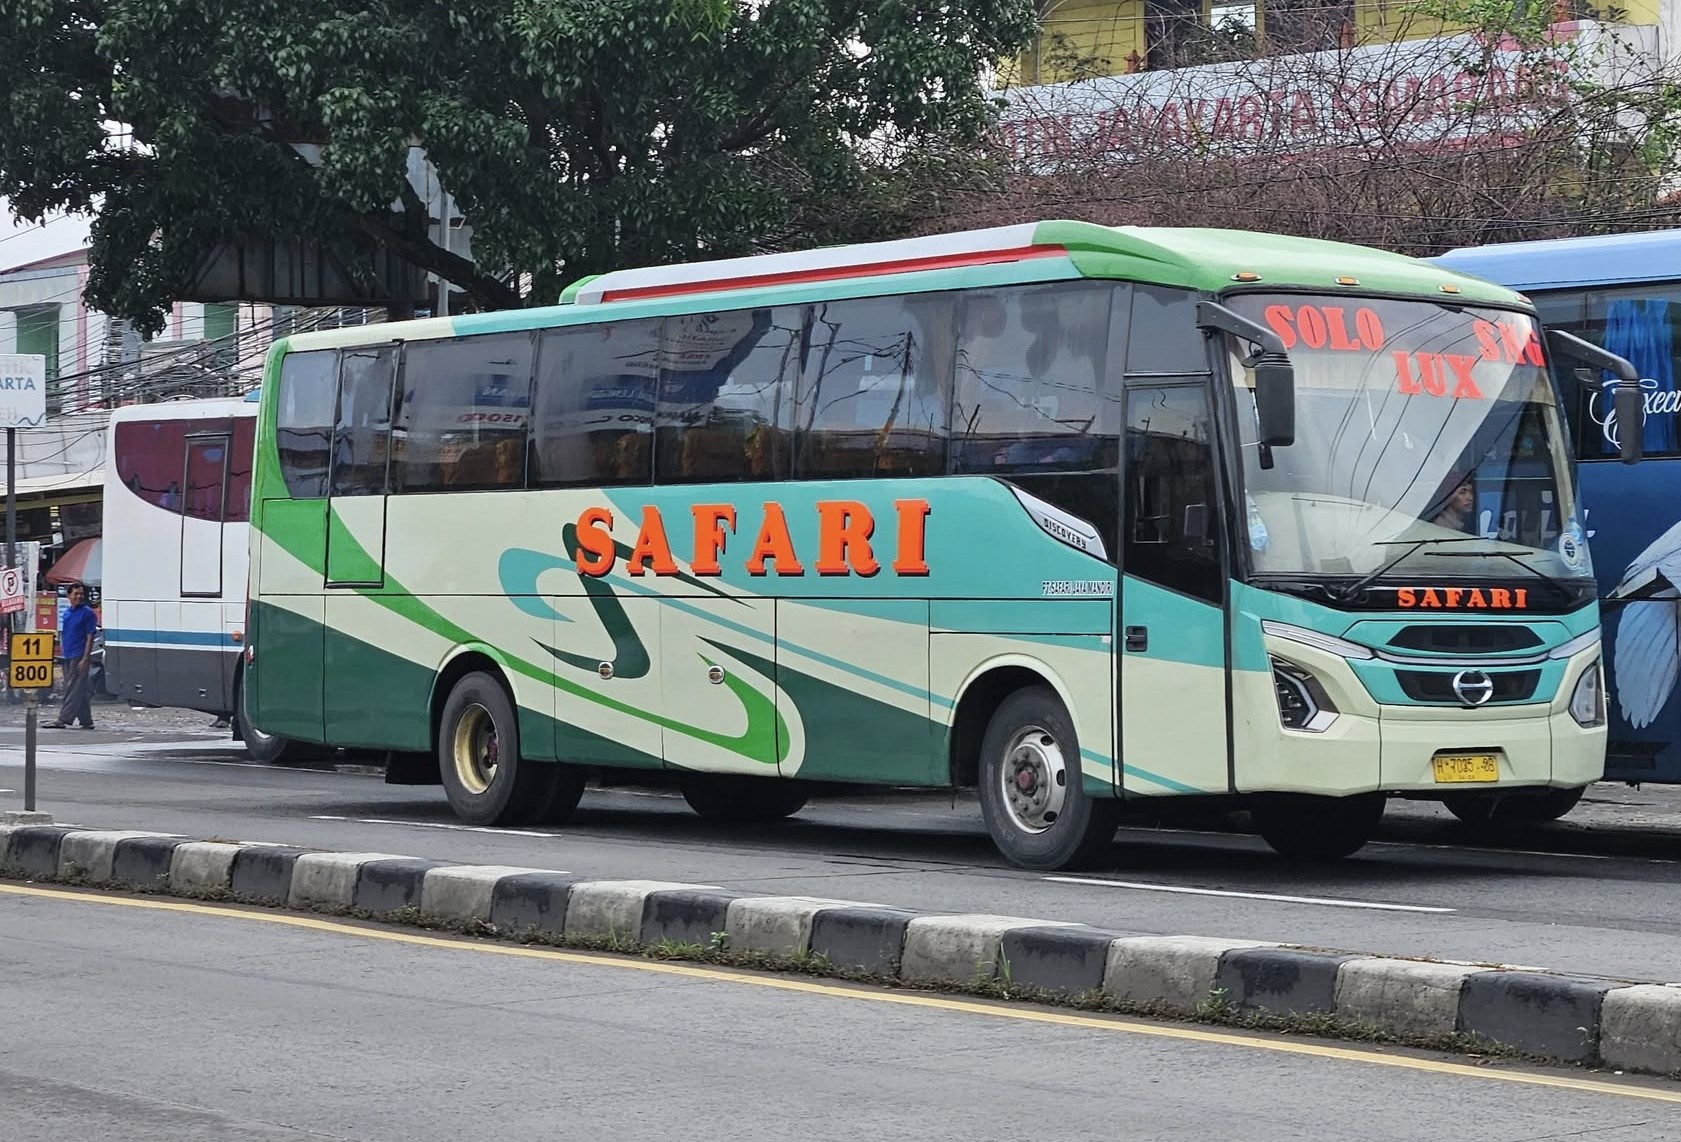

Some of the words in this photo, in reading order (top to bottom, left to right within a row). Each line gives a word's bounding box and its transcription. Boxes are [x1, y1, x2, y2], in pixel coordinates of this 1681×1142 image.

[1264, 305, 1384, 351] SOLO
[1393, 350, 1484, 399] LUX
[575, 499, 931, 578] SAFARI
[1397, 586, 1528, 608] SAFARI
[22, 638, 40, 655] 11
[15, 665, 47, 681] 800
[1437, 758, 1444, 773] H
